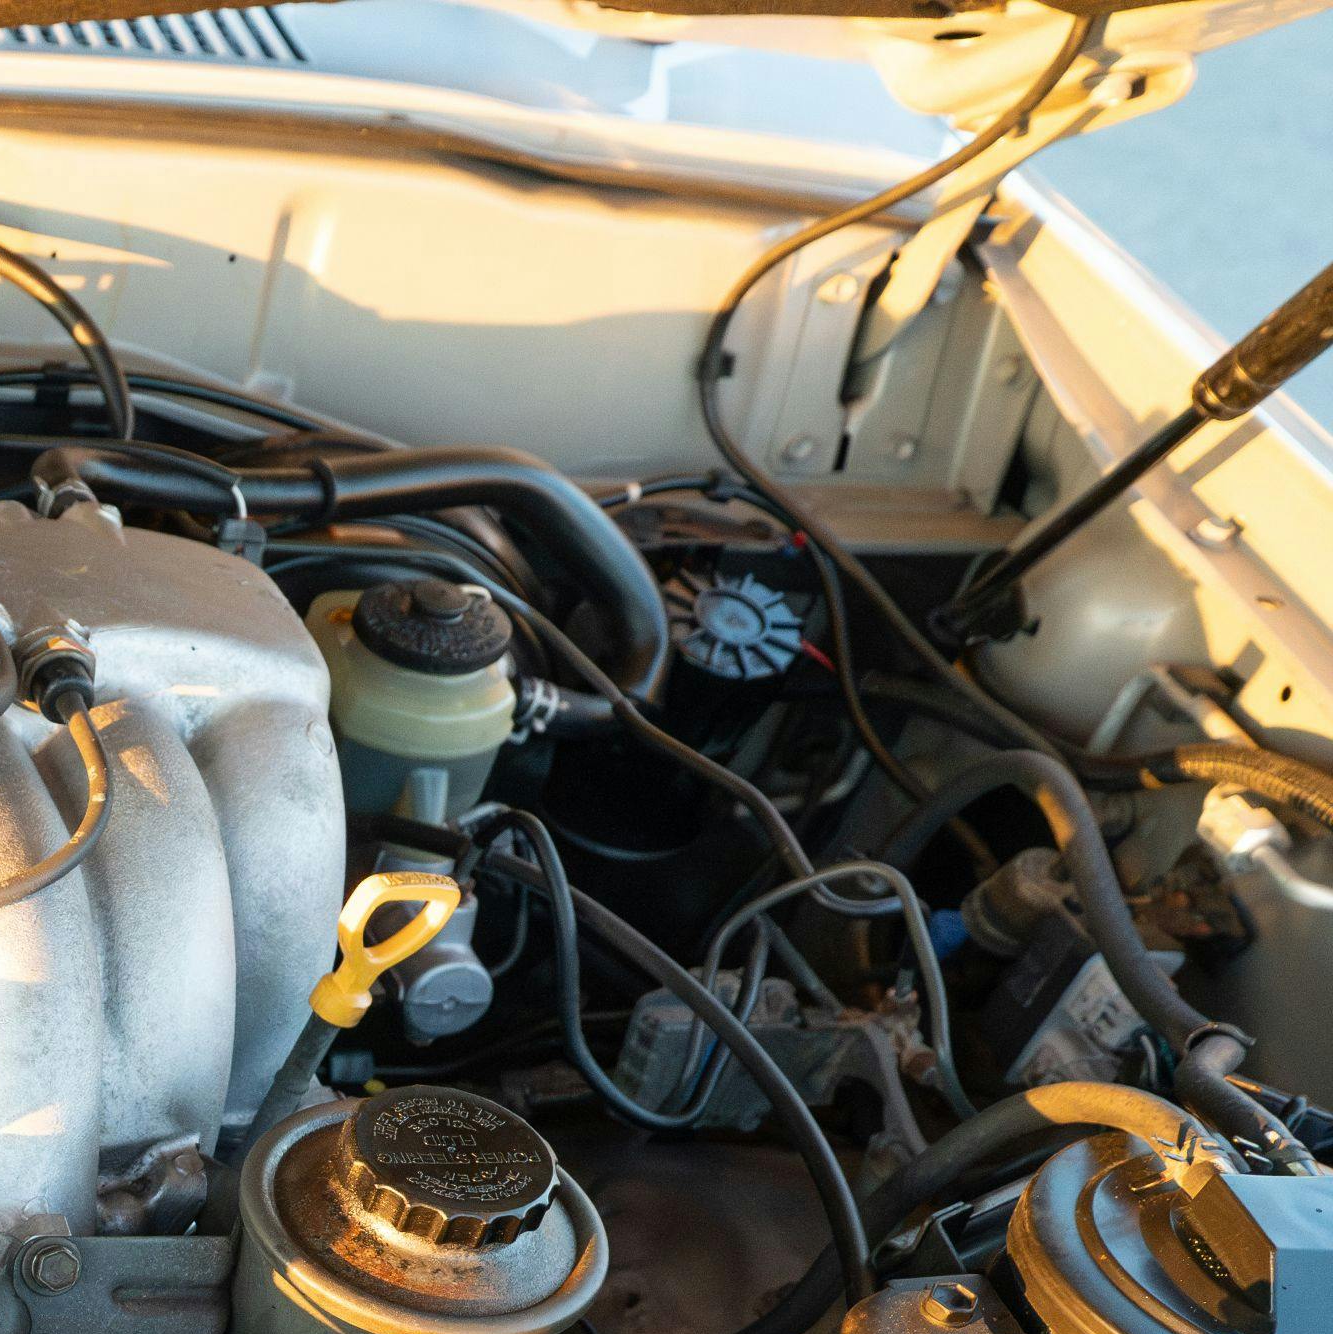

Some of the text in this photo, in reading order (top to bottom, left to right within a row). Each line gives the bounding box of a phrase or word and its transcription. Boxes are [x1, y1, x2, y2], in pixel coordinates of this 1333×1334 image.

[423, 1134, 477, 1147] FLUID
[376, 1151, 542, 1164] POWER STEERING
